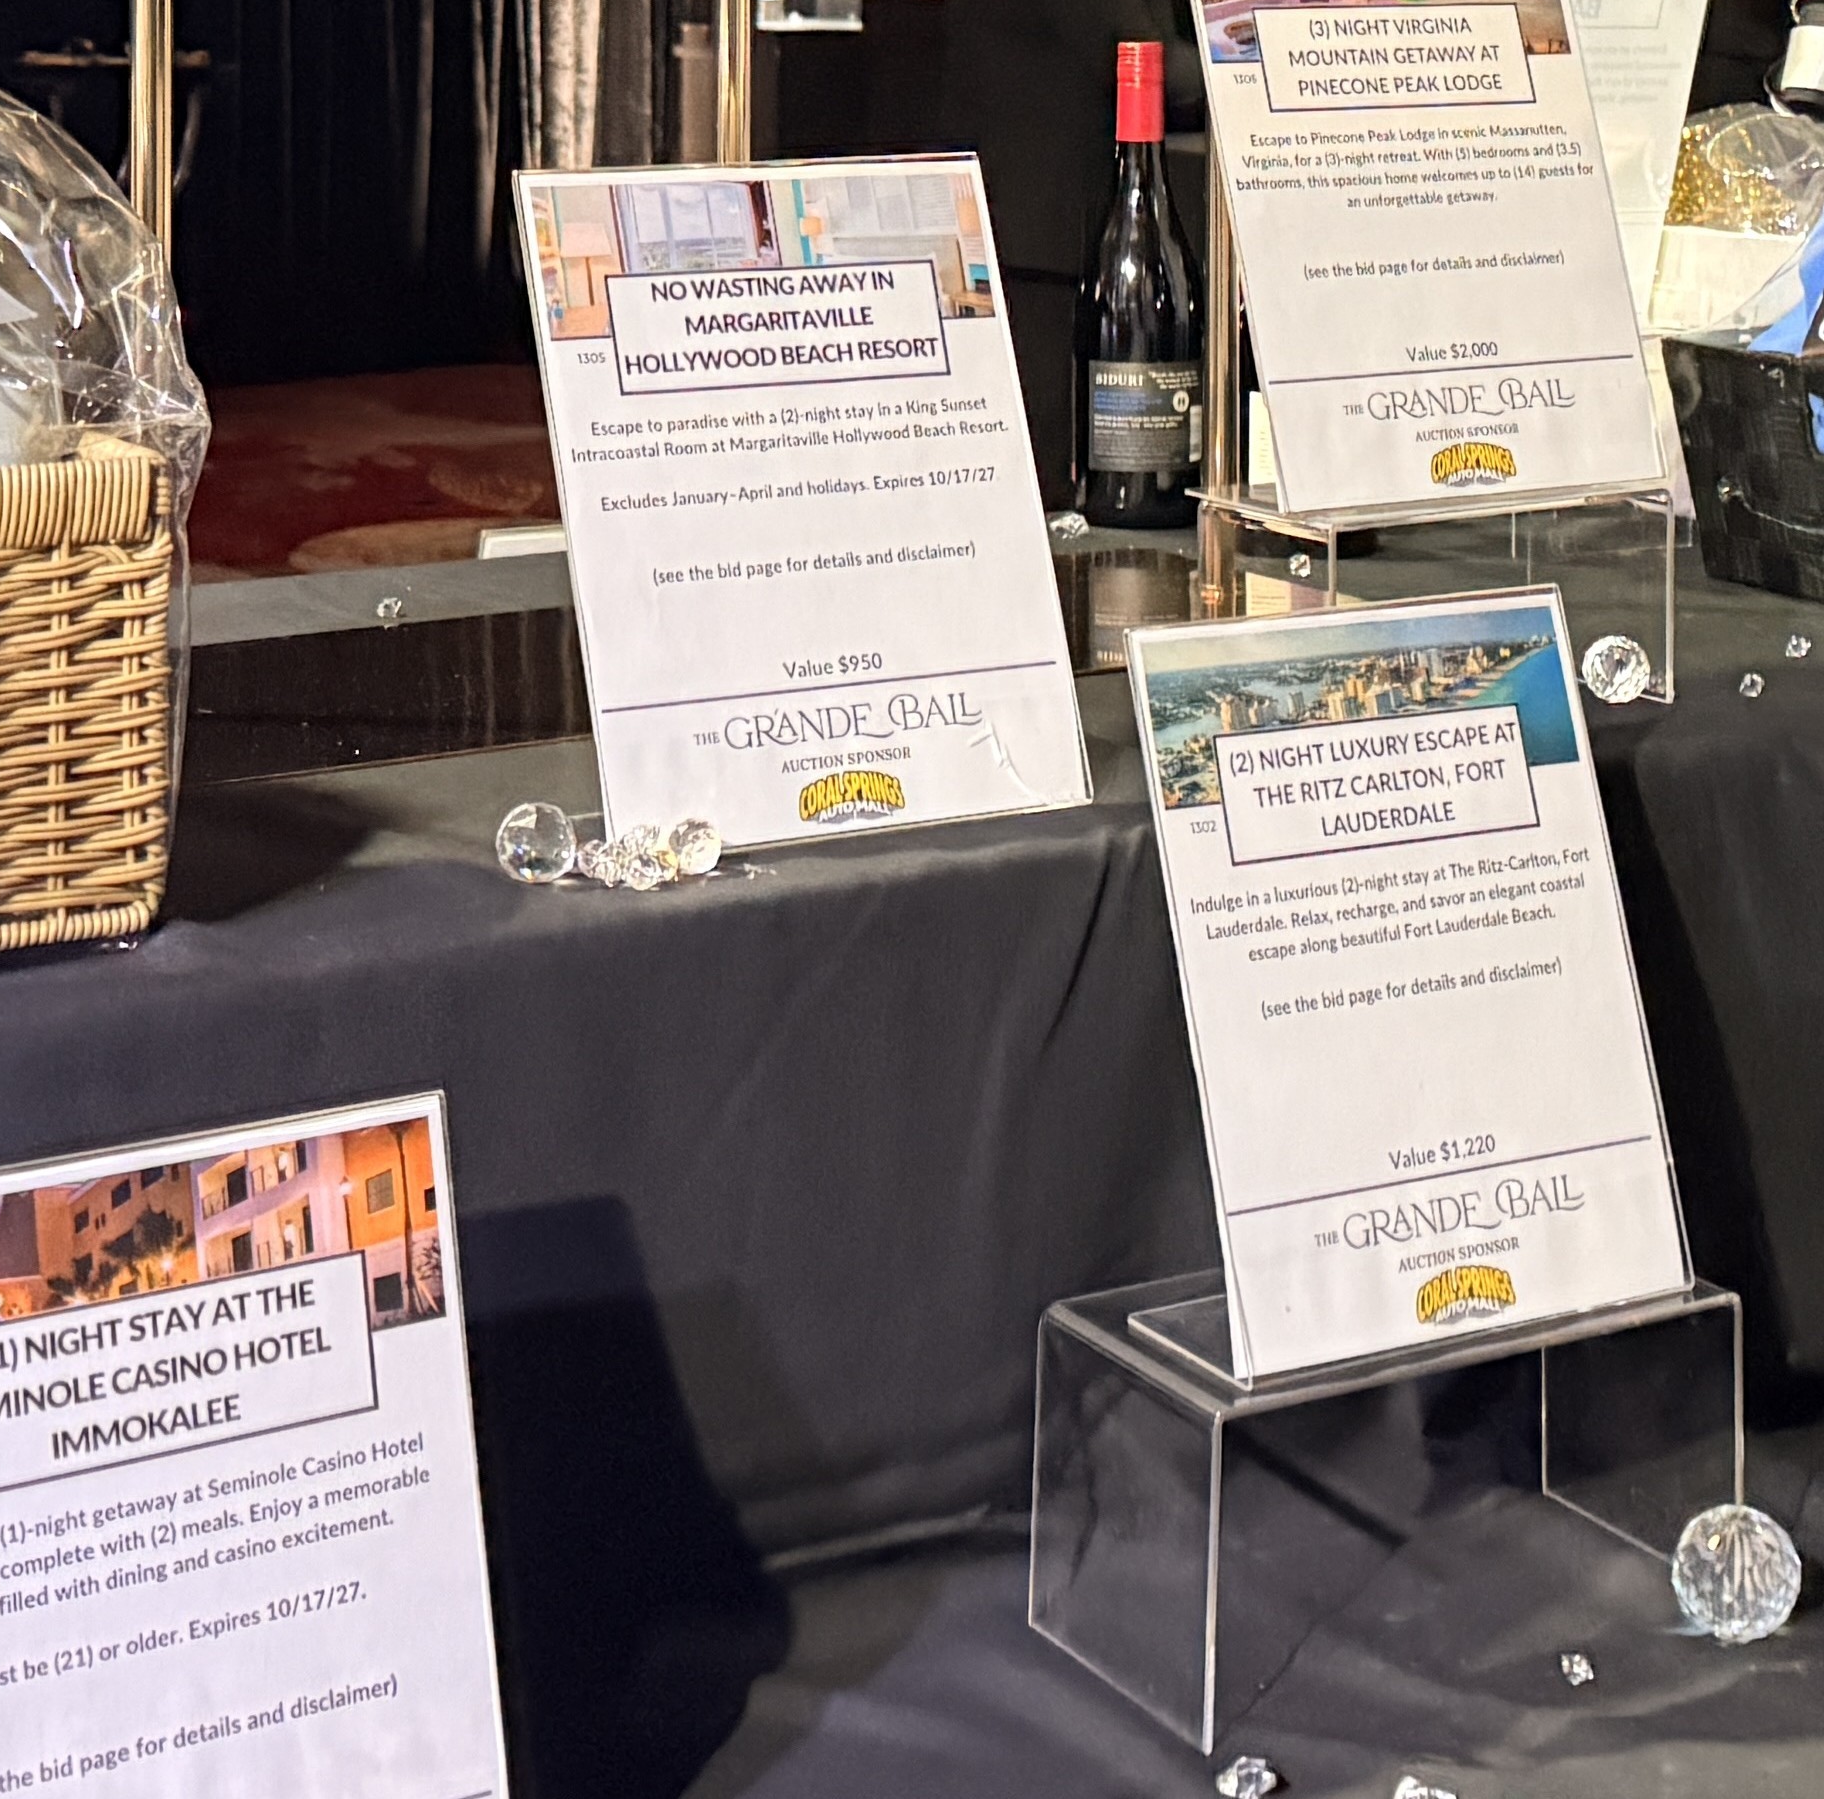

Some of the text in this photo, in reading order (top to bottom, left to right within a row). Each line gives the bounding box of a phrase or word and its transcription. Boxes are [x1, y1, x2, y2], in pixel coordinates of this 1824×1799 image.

[1309, 17, 1472, 39] (3) NIGHT VIRGINIA
[1288, 44, 1500, 67] MOUNTAIN GETAWAY AT
[1297, 73, 1502, 97] PINECONE PEAK LODGE
[650, 270, 895, 302] NO WASTING AWAY IN
[684, 306, 874, 336] MARGARITAVILLE
[624, 336, 938, 375] HOLLYWOOD BEACH RESORT
[1405, 341, 1498, 362] Value $2,000
[1367, 377, 1576, 421] GRANDE BALL
[782, 652, 883, 679] Value $950
[693, 691, 982, 749] THE GRANDE BALL
[1229, 721, 1516, 777] (2) NIGHT LUXURY ESCAPE AT
[1252, 758, 1505, 808] THE RITZ CARLTON, FORT
[1320, 800, 1456, 837] LAUDERDALE
[1387, 1133, 1496, 1170] Value $1,220
[1314, 1174, 1585, 1249] THE GRANDE BALL
[24, 1317, 123, 1364] NIGHT
[128, 1300, 206, 1342] STAY
[211, 1291, 251, 1326] AT
[255, 1278, 315, 1316] THE
[111, 1347, 228, 1395] CASINO
[233, 1326, 332, 1371] HOTEL
[51, 1393, 241, 1459] IMMOKALEE
[22, 1659, 49, 1680] be
[53, 1644, 93, 1676] (21)
[98, 1643, 120, 1661] or
[125, 1629, 183, 1655] older.
[188, 1610, 261, 1640] Expires
[266, 1581, 367, 1621] 10/17/27.
